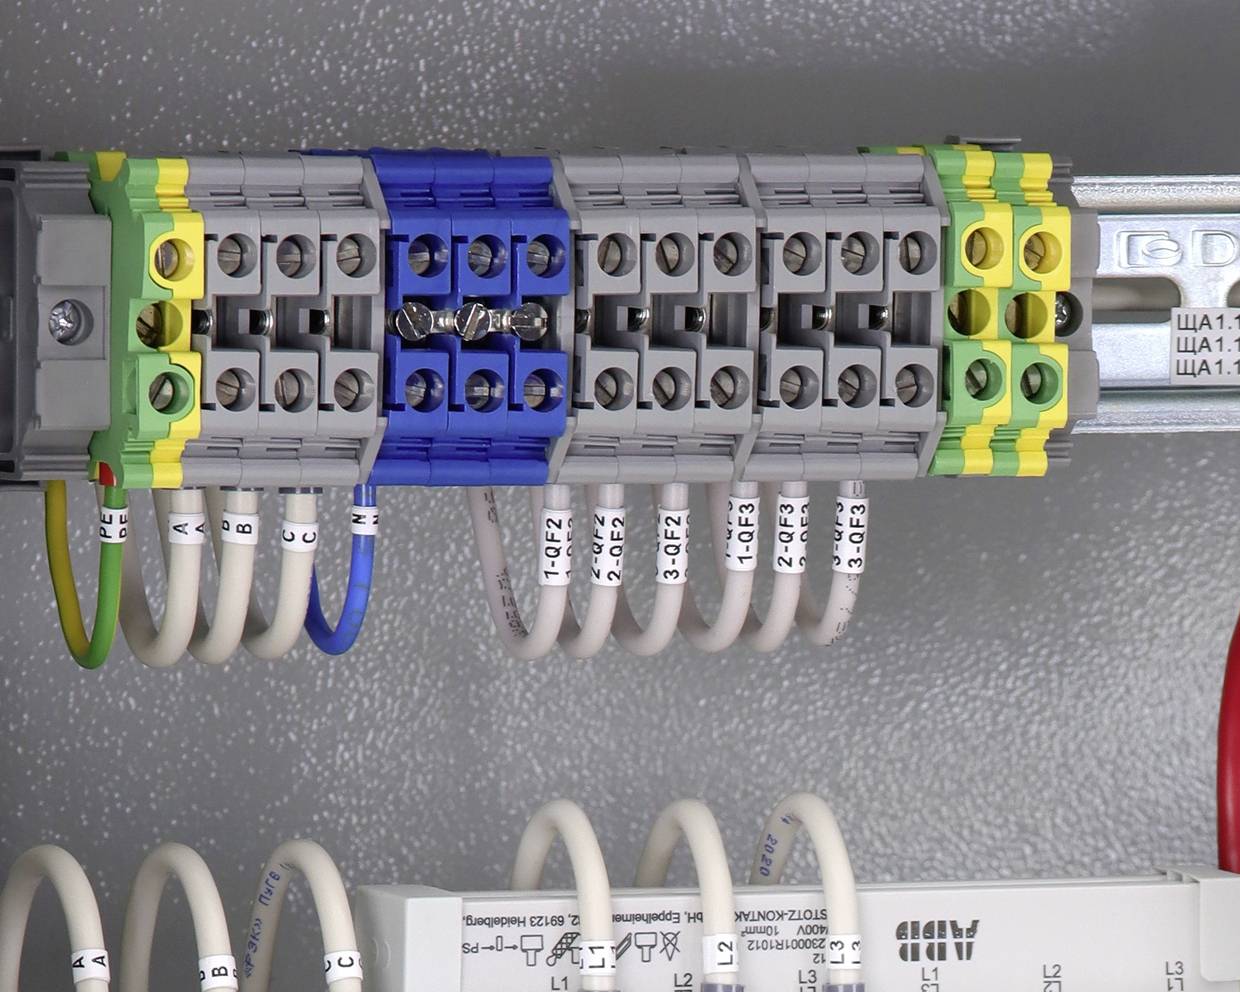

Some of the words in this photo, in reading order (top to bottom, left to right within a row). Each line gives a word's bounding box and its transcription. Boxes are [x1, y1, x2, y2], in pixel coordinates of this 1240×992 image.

[100, 513, 112, 538] PE
[352, 513, 366, 524] N
[173, 521, 189, 536] A
[236, 522, 252, 535] B
[737, 502, 755, 565] 1-QF3
[777, 503, 795, 568] 2-QF3
[848, 503, 867, 568] 3-QF3
[282, 530, 296, 543] C
[302, 531, 317, 544] C
[543, 517, 563, 580] 1-QF2
[608, 516, 625, 581] 2-QF2
[663, 515, 682, 580] 3-QF2
[463, 914, 526, 928] Heidelberg,
[530, 914, 564, 927] 69123
[735, 909, 828, 922] STOTZ-KONTAK
[895, 919, 980, 962] ABB
[463, 943, 479, 954] PS
[718, 941, 733, 966] L2
[830, 940, 845, 964] L3
[92, 955, 106, 967] A
[338, 956, 354, 968] C
[588, 945, 605, 968] L1
[212, 965, 228, 978] B
[921, 967, 939, 981] L1
[1043, 964, 1062, 979] L2
[1165, 961, 1184, 976] L3
[551, 976, 568, 990] L1
[674, 973, 693, 987] L2
[798, 969, 817, 984] L3
[1167, 978, 1184, 992] L1
